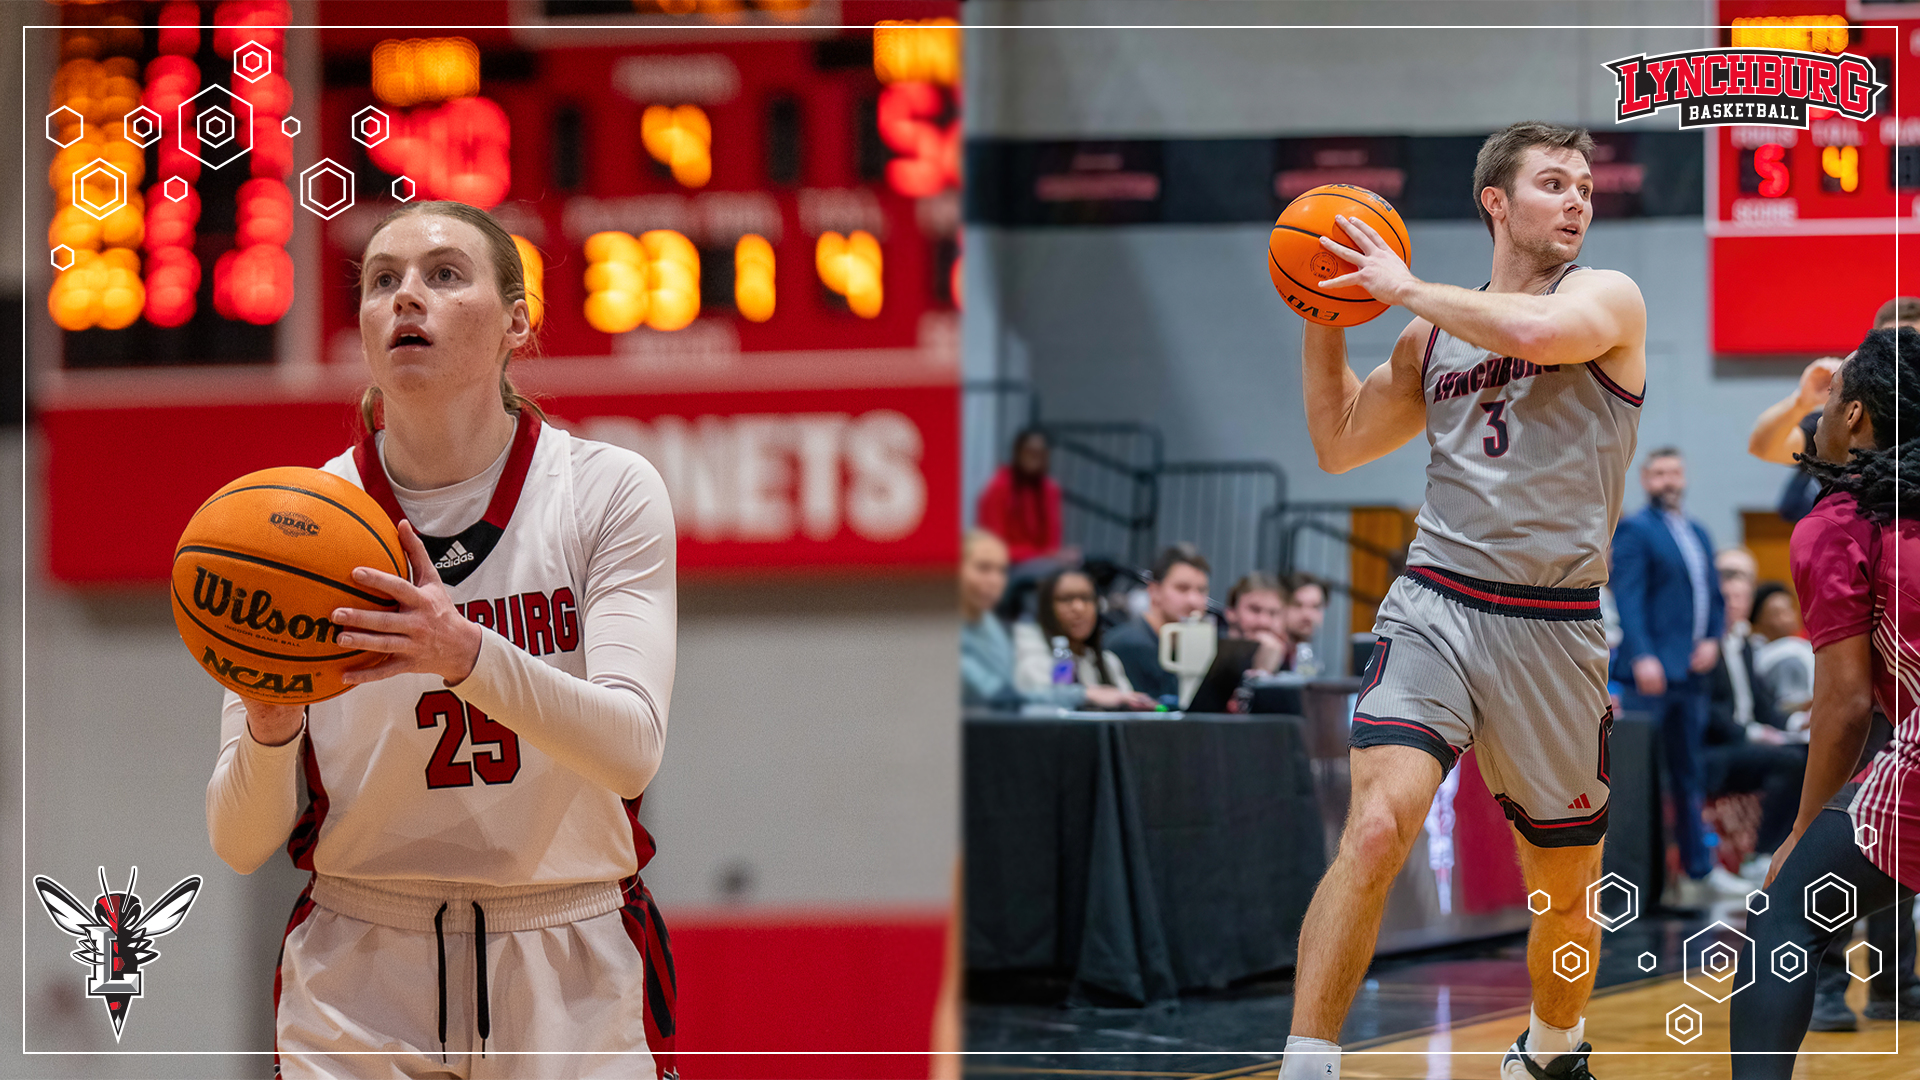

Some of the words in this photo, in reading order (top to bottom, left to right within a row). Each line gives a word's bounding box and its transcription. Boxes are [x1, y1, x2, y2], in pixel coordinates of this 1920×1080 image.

[1754, 143, 1790, 198] 5
[1822, 145, 1859, 193] 4
[1287, 294, 1340, 322] EVO
[1433, 356, 1560, 404] LYNCHBU
[1479, 399, 1510, 459] 3
[588, 410, 929, 541] NETS
[270, 513, 319, 535] ODAC
[435, 551, 475, 570] adidas
[193, 565, 344, 644] Wilson
[454, 586, 580, 657] BURG
[224, 624, 253, 637] INDOOR
[255, 634, 278, 643] GAME
[280, 640, 301, 648] BALL
[202, 645, 314, 694] NCAA
[415, 689, 521, 790] 25
